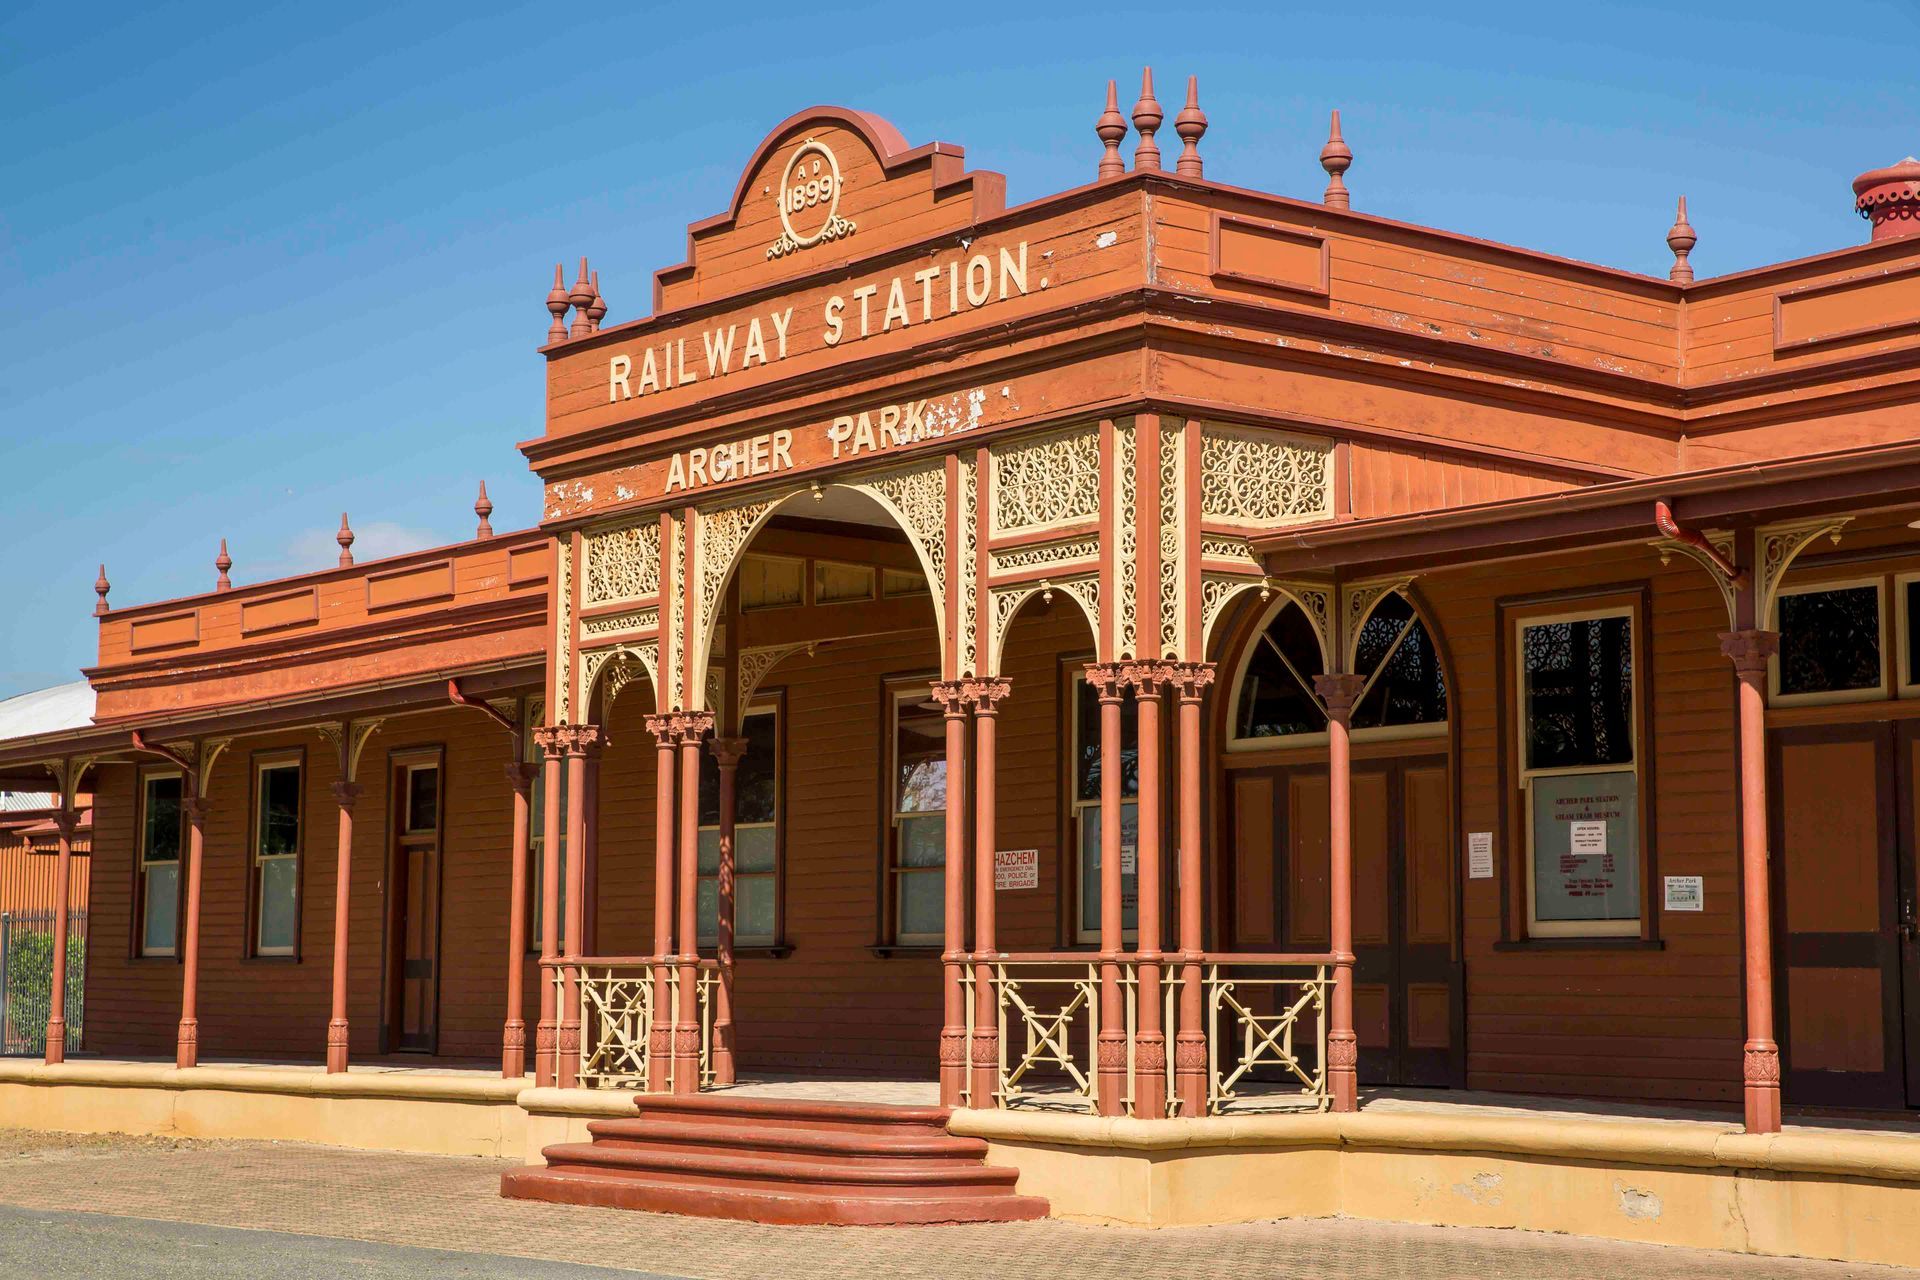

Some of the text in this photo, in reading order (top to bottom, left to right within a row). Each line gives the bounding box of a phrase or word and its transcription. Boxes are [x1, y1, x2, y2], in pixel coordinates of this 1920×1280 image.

[787, 174, 834, 214] 1899
[609, 307, 794, 403] RAILWAY
[665, 399, 928, 494] ARCHER PARK
[995, 851, 1035, 866] HAZCHEM
